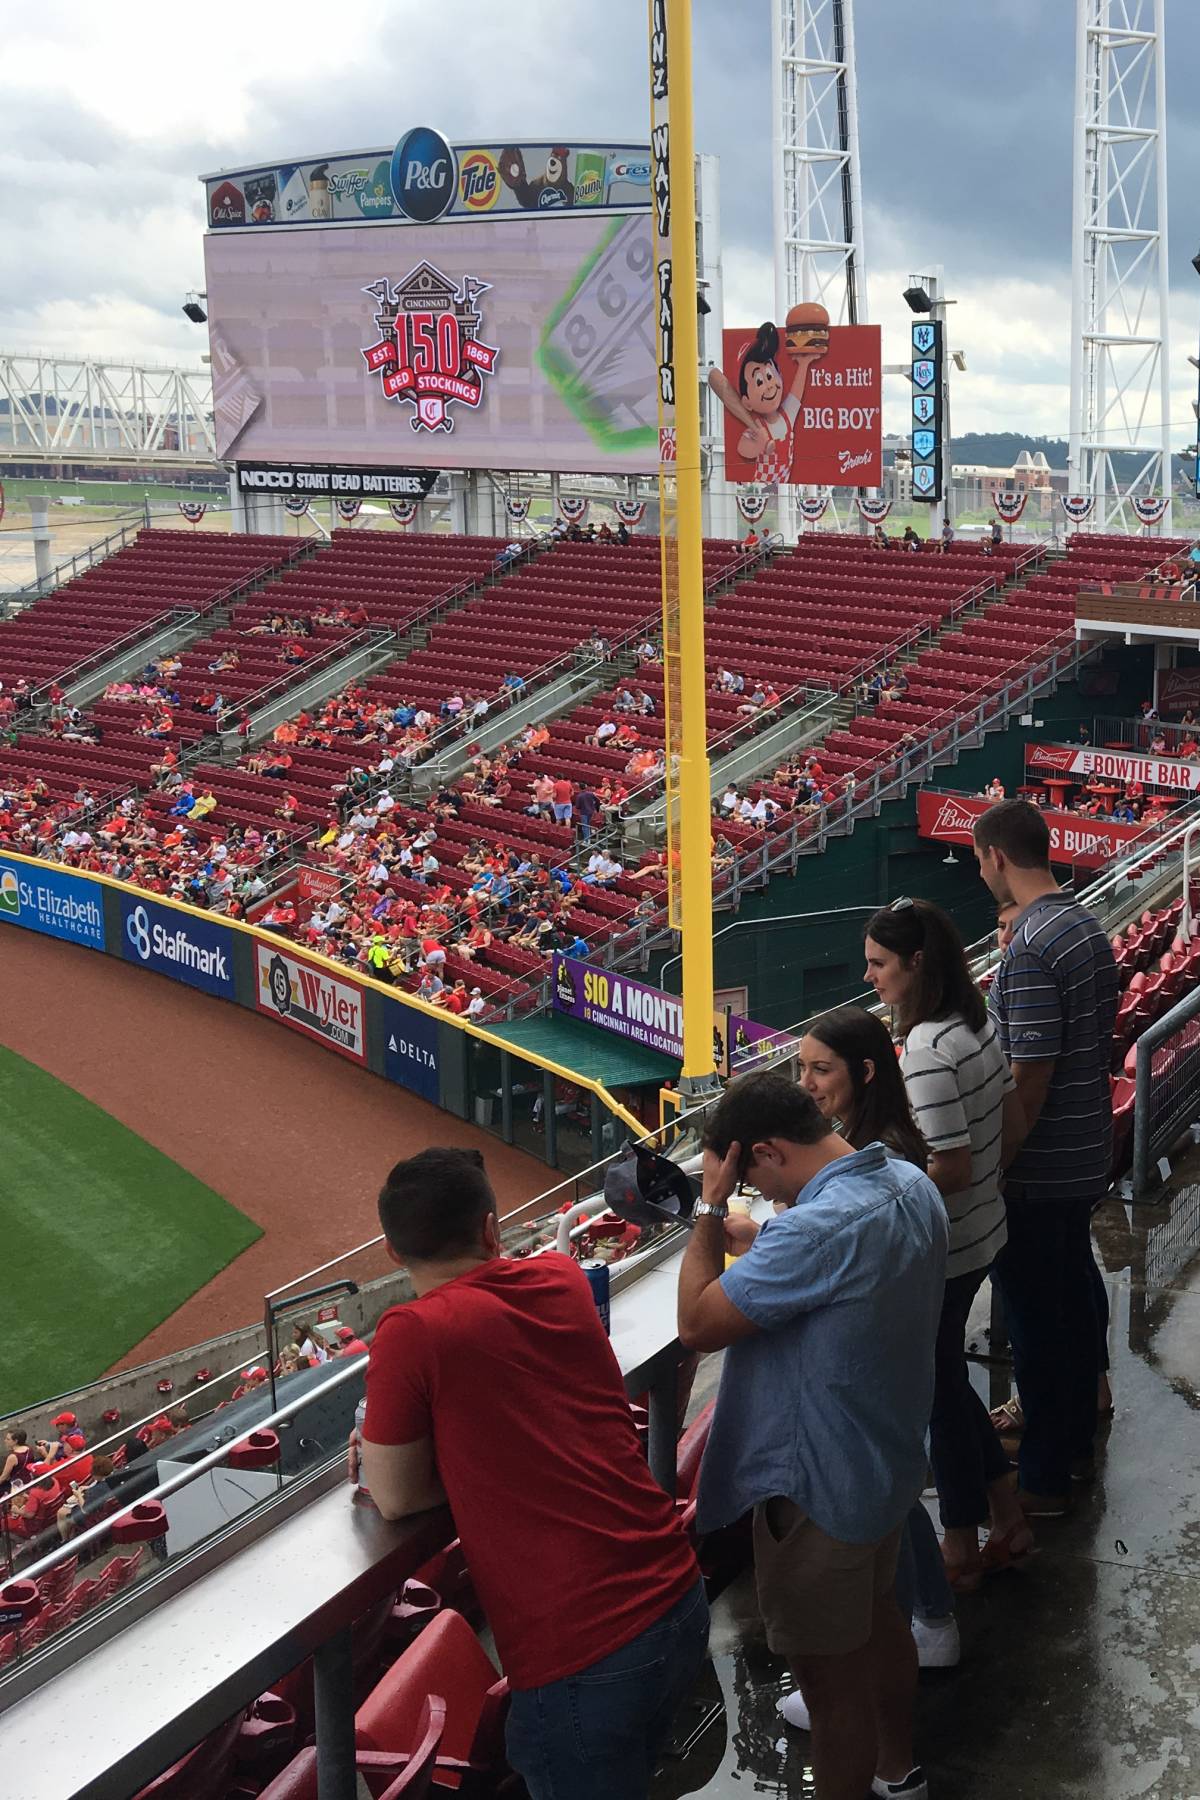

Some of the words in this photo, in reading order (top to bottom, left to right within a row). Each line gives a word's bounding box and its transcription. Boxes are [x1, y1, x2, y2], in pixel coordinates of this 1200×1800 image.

[328, 171, 369, 197] Swiffer
[404, 159, 447, 190] P&G
[461, 165, 496, 202] Tide
[652, 122, 671, 237] WAY
[213, 207, 225, 220] Old
[224, 207, 242, 220] Spice
[360, 193, 392, 208] Pampers
[405, 299, 449, 309] CINCINNATI
[393, 313, 460, 376] 150
[658, 260, 675, 405] FAIR
[372, 347, 391, 363] EST.
[467, 345, 489, 363] 1869
[389, 371, 409, 390] RED
[418, 375, 477, 401] STOCKINGS
[811, 368, 832, 386] It's
[834, 373, 843, 386] a
[846, 367, 873, 386] Hit!
[803, 407, 834, 429] BIG
[838, 407, 876, 430] BOY
[838, 449, 873, 474] Frisch's
[240, 470, 293, 488] NOCO
[296, 472, 330, 489] START
[331, 474, 360, 490] DEAD
[1034, 750, 1068, 765] Budweiser
[1084, 753, 1092, 773] THE
[1094, 754, 1153, 783] BOWTIE
[1157, 764, 1191, 788] BAR
[37, 886, 101, 927] Elizabeth
[39, 912, 101, 939] HEALTHCARE
[153, 924, 226, 980] Staffmark
[274, 972, 285, 996] 45
[297, 968, 358, 1029] Wyler
[584, 970, 609, 1009] $10
[612, 981, 623, 1015] A
[592, 1010, 630, 1035] CINCINNATI
[631, 1025, 648, 1043] AREA
[400, 1039, 436, 1069] DELTA
